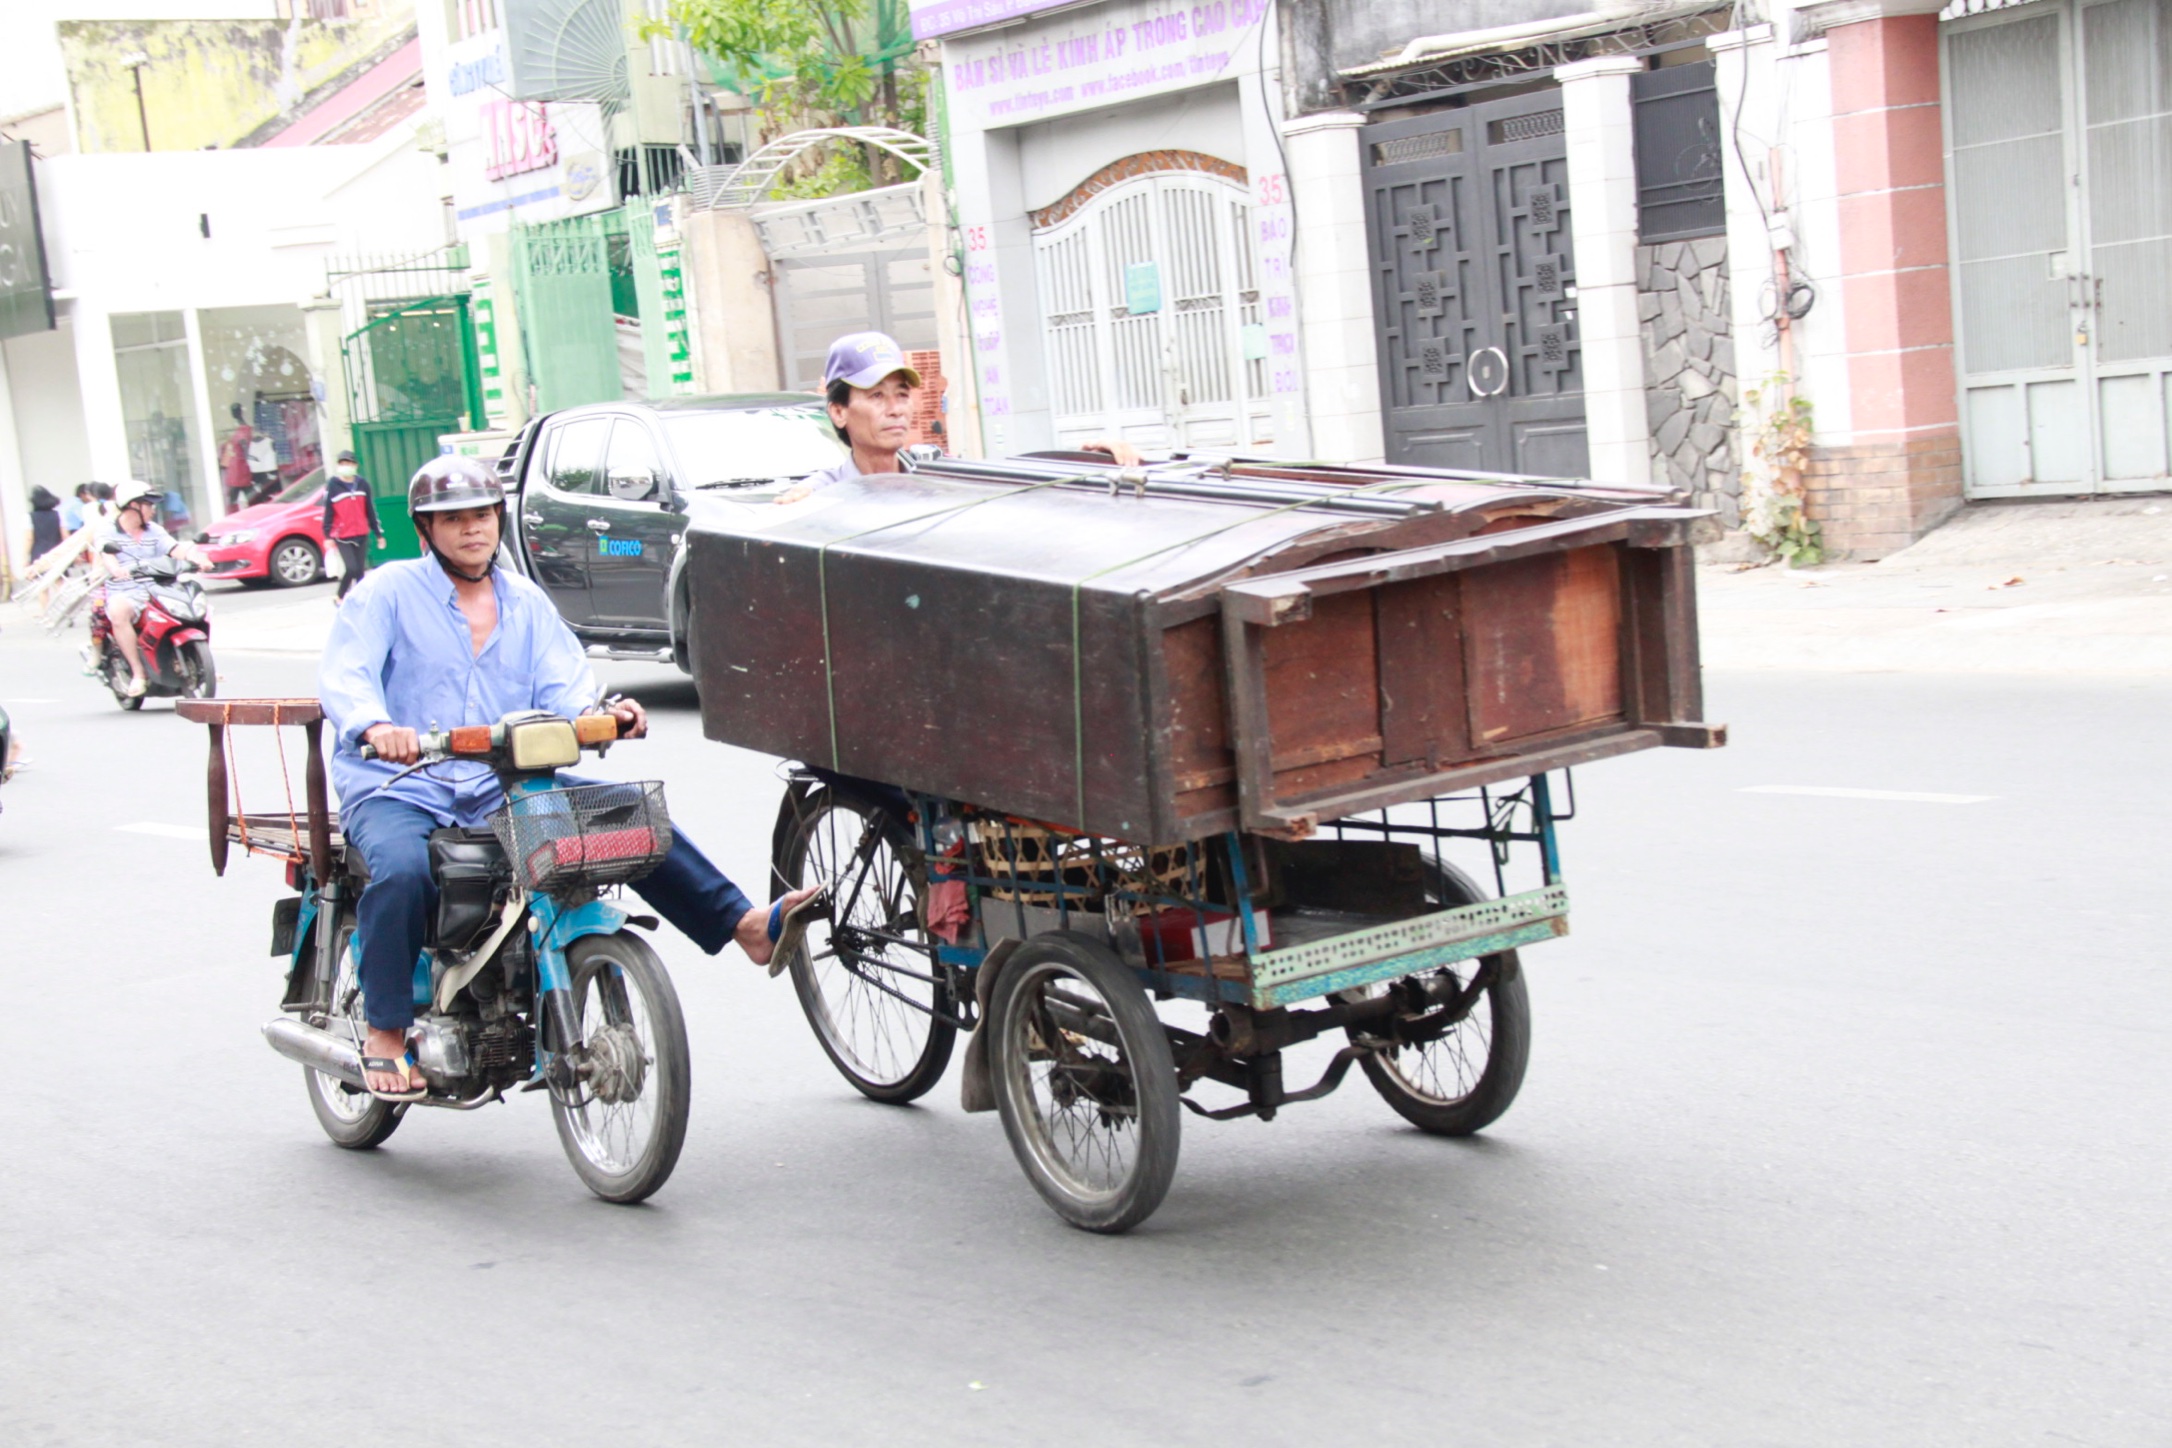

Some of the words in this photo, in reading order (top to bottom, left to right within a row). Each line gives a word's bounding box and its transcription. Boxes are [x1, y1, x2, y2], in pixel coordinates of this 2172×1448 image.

[954, 54, 985, 92] BÁN
[1008, 43, 1029, 80] VÀ
[1056, 30, 1099, 70] KÍNH
[1104, 21, 1126, 61] ÁP
[1132, 8, 1188, 52] TRÒNG
[1192, 0, 1227, 39] CAO
[1259, 174, 1283, 206] 35
[968, 226, 986, 251] 35
[608, 540, 642, 556] COFICO
